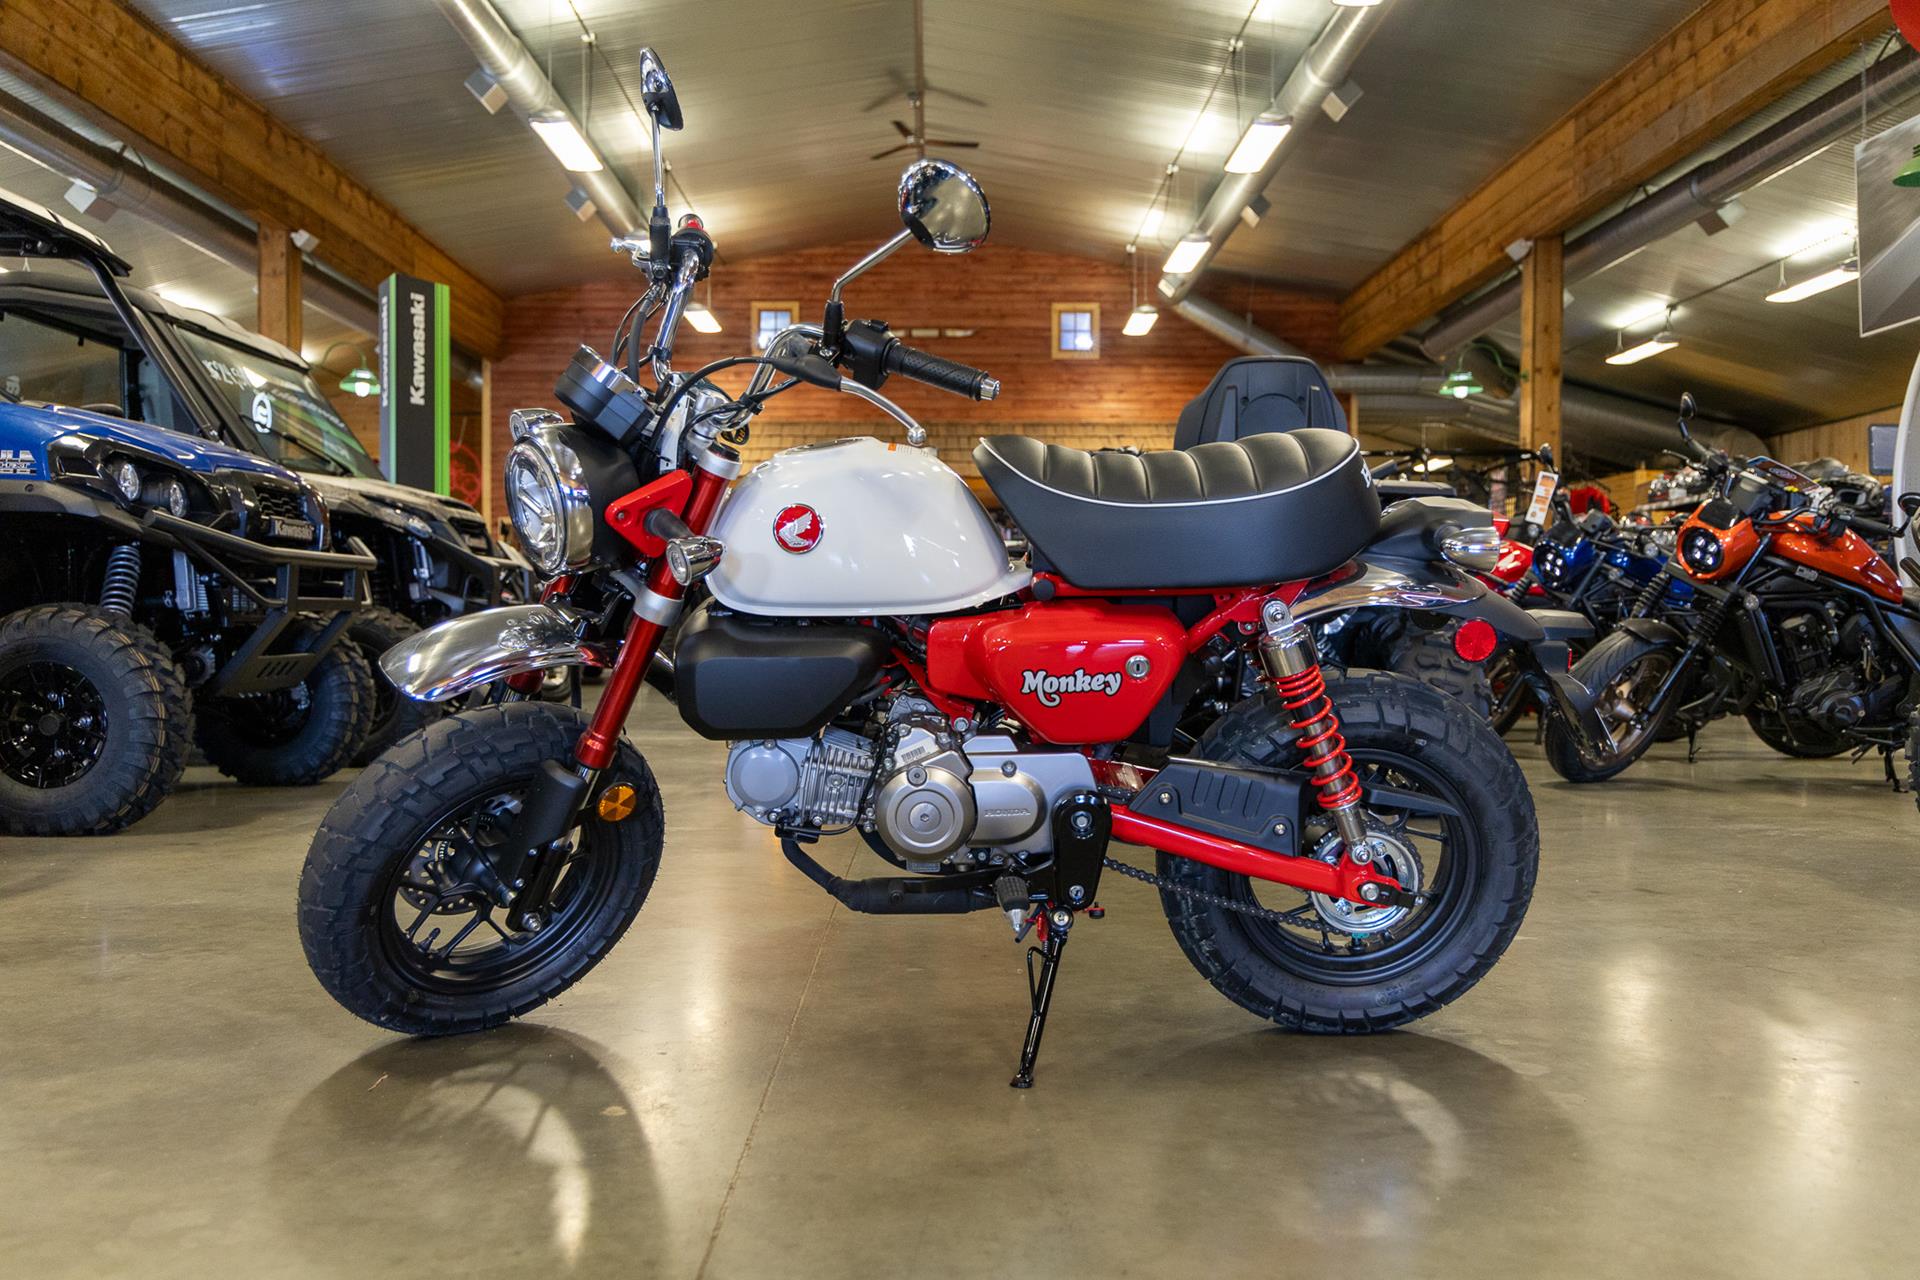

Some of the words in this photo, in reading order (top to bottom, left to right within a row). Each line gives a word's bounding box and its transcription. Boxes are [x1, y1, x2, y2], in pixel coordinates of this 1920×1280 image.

[409, 291, 426, 406] Kawasaki
[1021, 667, 1122, 707] Monkey
[983, 807, 1031, 818] HONDA
